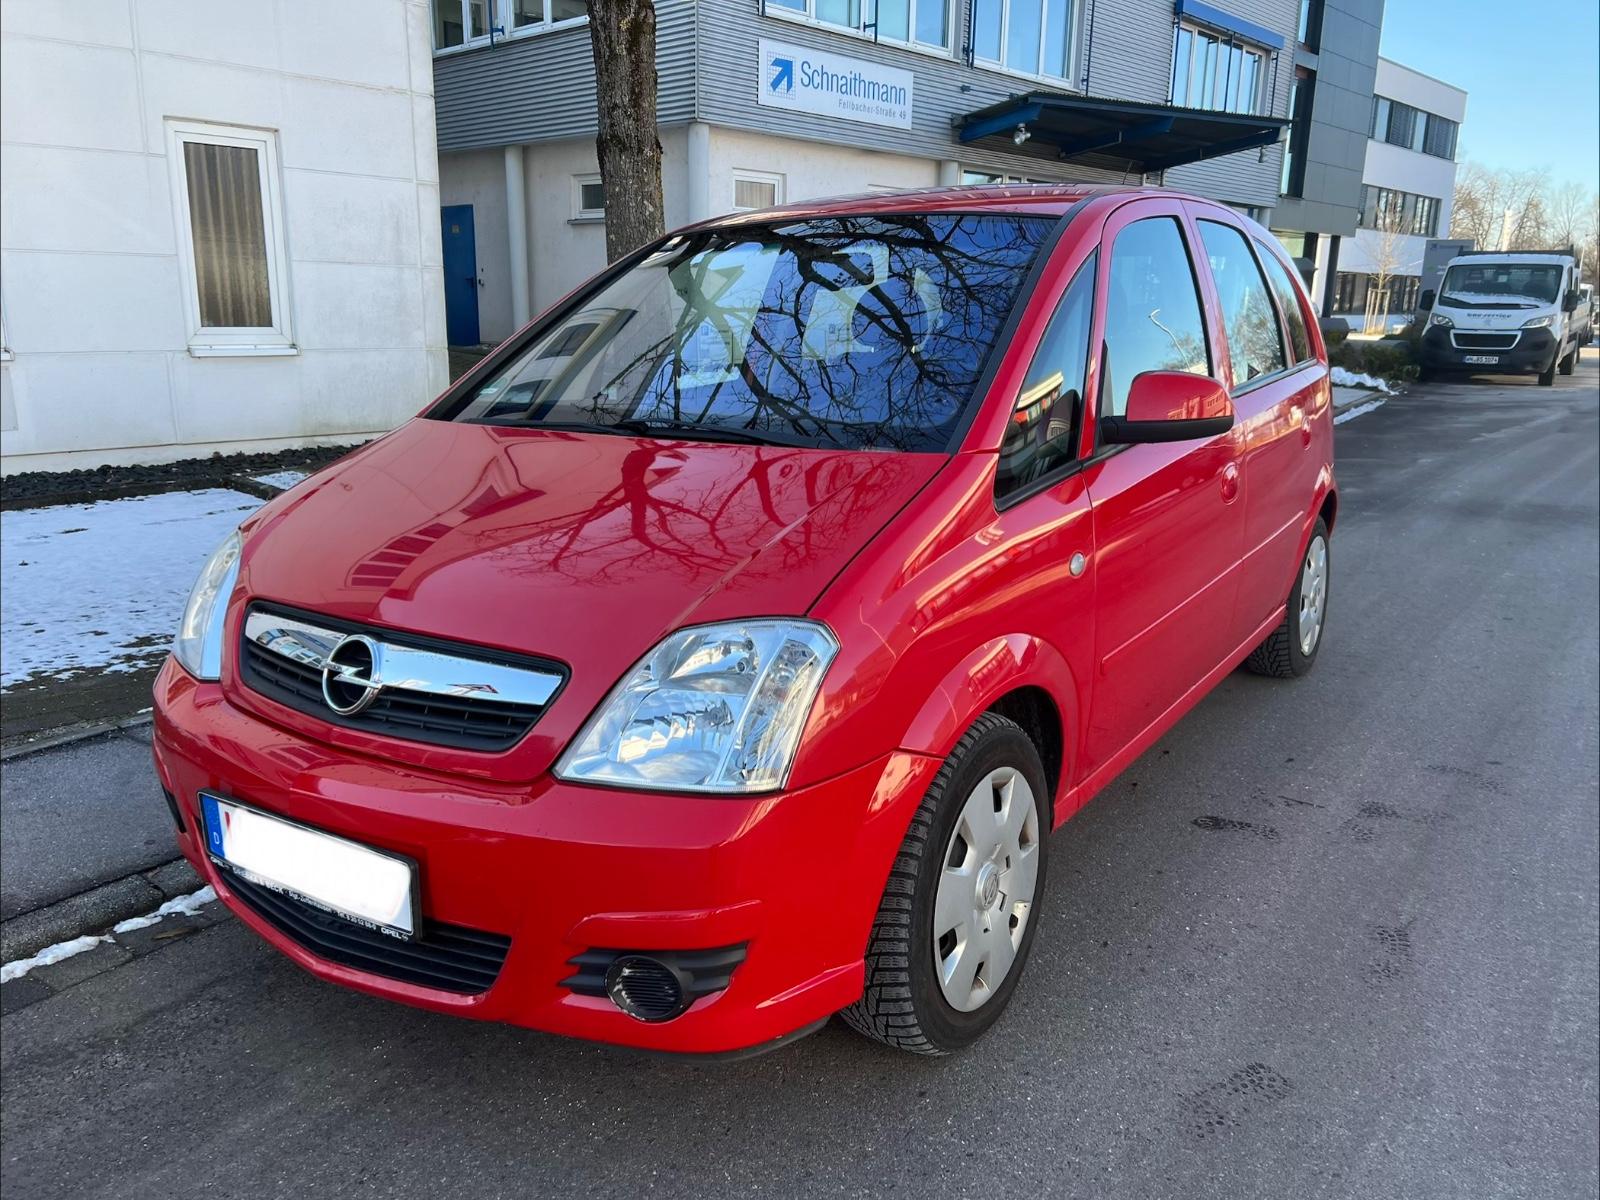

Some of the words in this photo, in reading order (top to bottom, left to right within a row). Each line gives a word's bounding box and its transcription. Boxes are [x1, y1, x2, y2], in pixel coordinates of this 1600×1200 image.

[800, 60, 906, 106] Schnaithmann
[213, 831, 220, 844] D
[381, 927, 402, 939] OPEL
